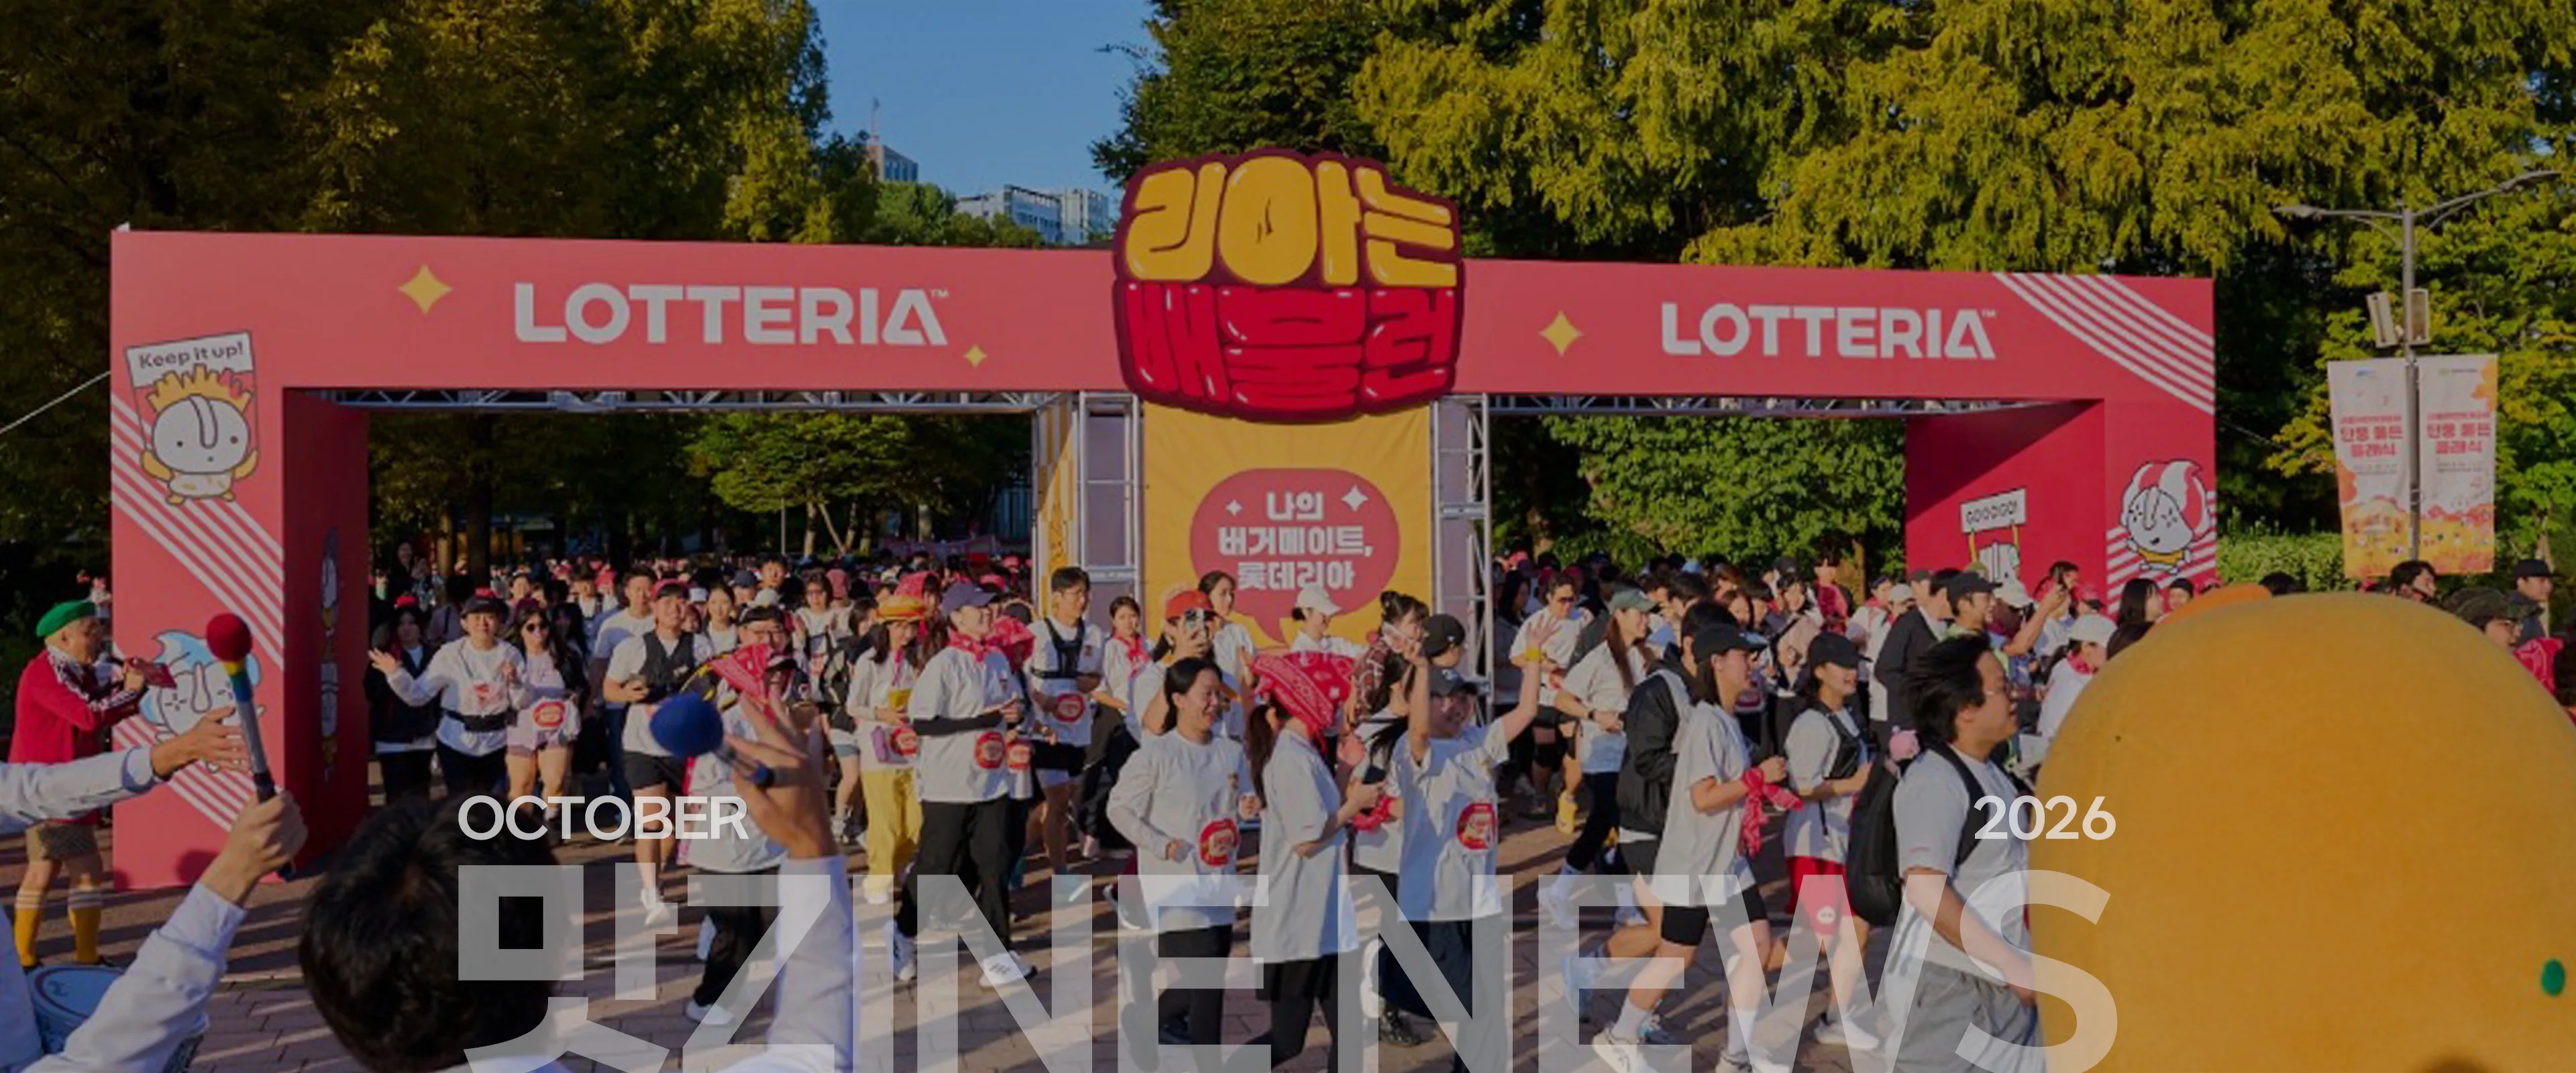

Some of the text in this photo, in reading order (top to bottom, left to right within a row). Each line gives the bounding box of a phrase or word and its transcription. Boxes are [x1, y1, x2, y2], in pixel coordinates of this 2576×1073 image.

[1125, 155, 1457, 286] 리아는
[515, 282, 947, 345] LOTTERIA
[1662, 302, 1996, 359] LOTTERIA
[139, 341, 243, 369] Keep it up!
[1267, 492, 1324, 521] 나의
[1218, 526, 1374, 557] 버거메이트,
[1238, 561, 1355, 589] 롯데리아
